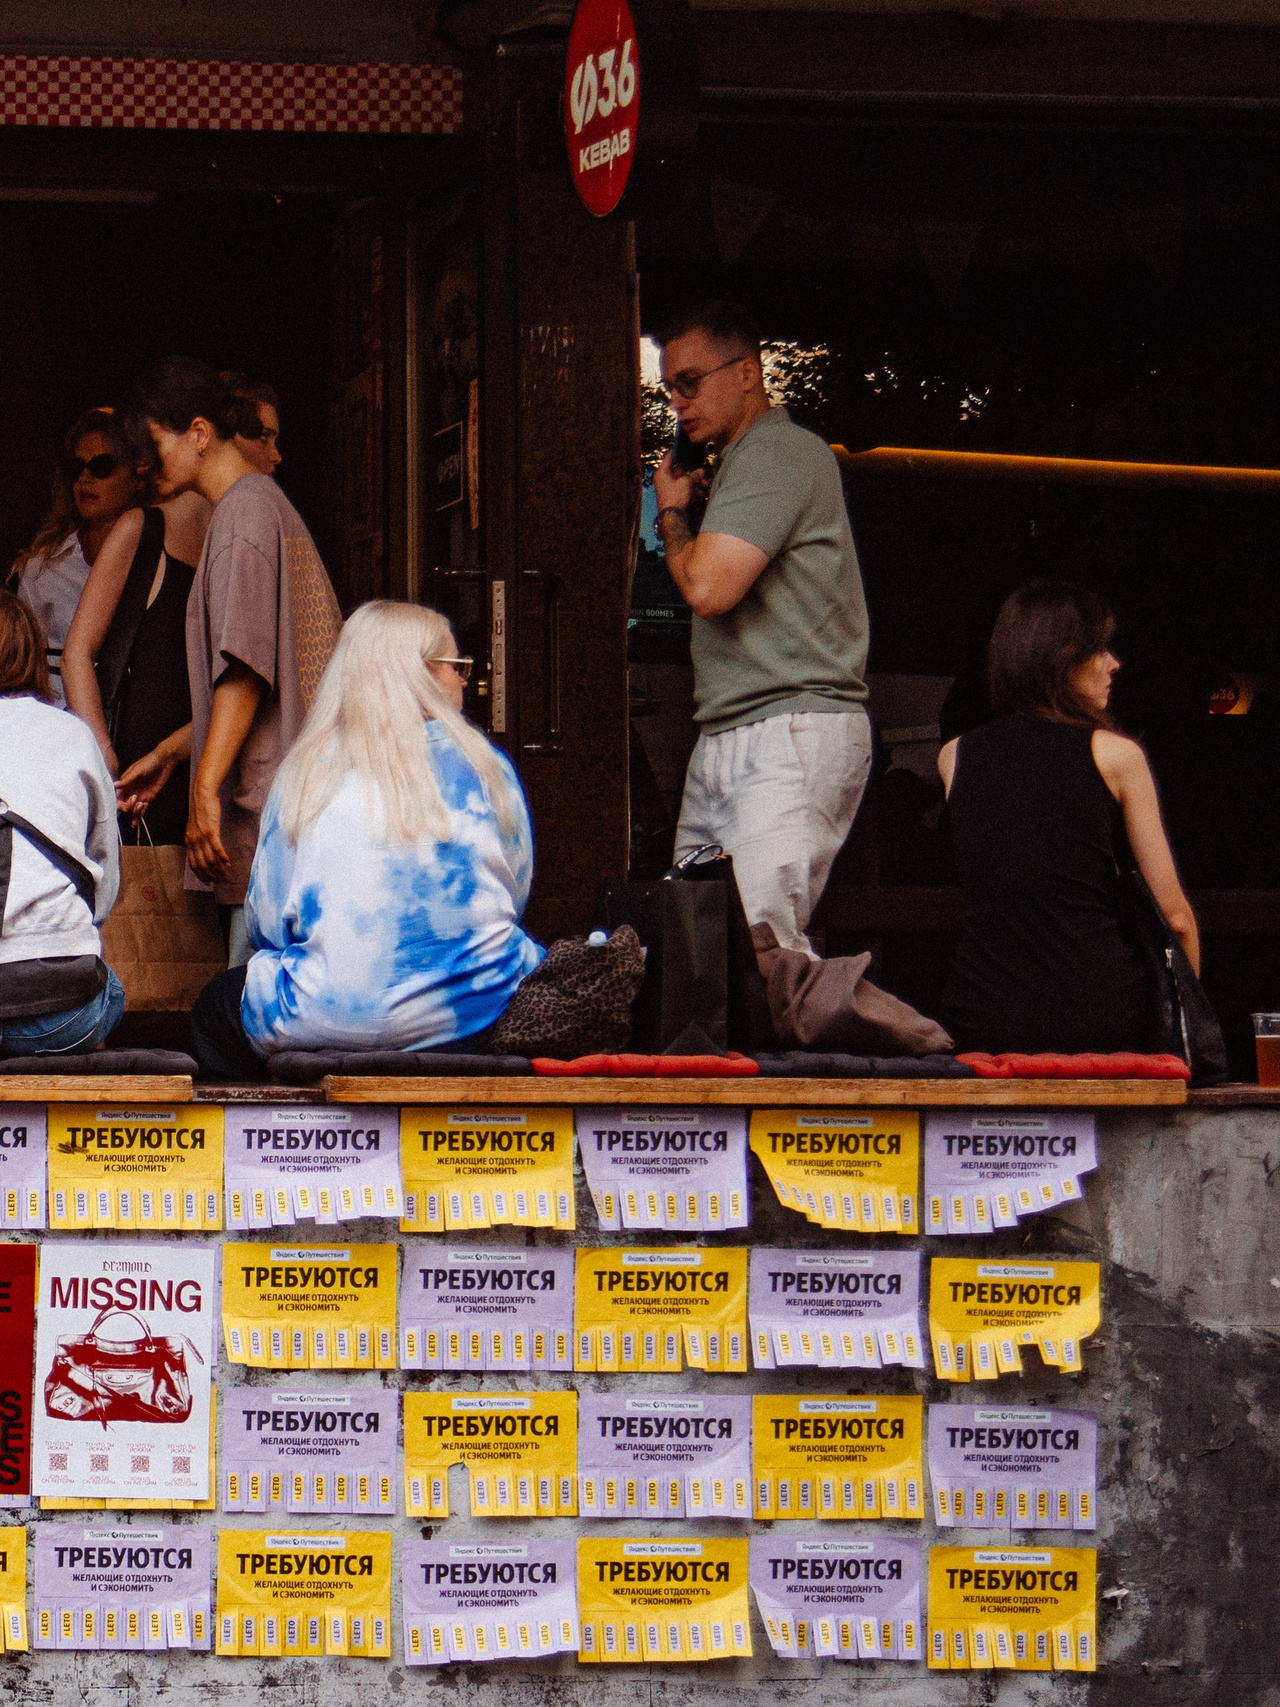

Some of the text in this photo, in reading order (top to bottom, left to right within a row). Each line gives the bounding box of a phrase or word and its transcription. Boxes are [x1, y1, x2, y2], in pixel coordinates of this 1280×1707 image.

[579, 129, 630, 173] KEBAB
[67, 1128, 205, 1149] ТРЕБУЮТСЯ
[243, 1128, 380, 1150] ТРЕБУЮТСЯ
[419, 1131, 555, 1152] ТРЕБУЮТСЯ
[593, 1131, 728, 1151] ТРЕБУЮТСЯ
[768, 1133, 901, 1155] ТРЕБУЮТСЯ
[944, 1135, 1076, 1156] ТРЕБУЮТСЯ
[85, 1155, 185, 1164] ЖЕЛАЮЩИЕ ОТДОХНУТЬ
[111, 1165, 166, 1173] СЭКОНОМИТЬ
[437, 1157, 535, 1166] ЖЕЛАЮЩИЕ ОТДОХНУТЬ
[241, 1267, 378, 1288] ТРЕБУЮТСЯ
[419, 1269, 555, 1290] ТРЕБУЮТСЯ
[594, 1271, 729, 1292] ТРЕБУЮТСЯ
[768, 1272, 901, 1294] ТРЕБУЮТСЯ
[50, 1277, 202, 1312] MISSING
[259, 1294, 358, 1302] ЖЕЛАЮЩИЕ ОТДОХНУТЬ
[611, 1298, 709, 1306] ЖЕЛАЮЩИЕ ОТДОХНУТЬ
[948, 1283, 1081, 1306] ТРЕБУЮТСЯ
[285, 1304, 340, 1312] СЭКОНОМИТЬ
[242, 1411, 380, 1433] ТРЕБУЮТСЯ
[423, 1416, 559, 1437] ТРЕБУЮТСЯ
[597, 1417, 732, 1439] ТРЕБУЮТСЯ
[771, 1419, 904, 1440] ТРЕБУЮТСЯ
[260, 1437, 359, 1447] ЖЕЛАЮЩИЕ ОТДОХНУТЬ
[946, 1428, 1079, 1450] ТРЕБУЮТСЯ
[286, 1448, 340, 1456] СЭКОНОМИТЬ
[964, 1455, 1060, 1464] ЖЕЛАЮЩИЕ ОТДОХНУТЬ
[988, 1465, 1041, 1473] СЭКОНОМИТЬ
[54, 1547, 193, 1569] ТРЕБУЮТСЯ
[236, 1554, 373, 1576] ТРЕБУЮТСЯ
[421, 1563, 557, 1585] ТРЕБУЮТСЯ
[595, 1562, 729, 1582] ТРЕБУЮТСЯ
[769, 1559, 902, 1580] ТРЕБУЮТСЯ
[254, 1581, 353, 1590] ЖЕЛАЮЩИЕ ОТДОХНУТЬ
[945, 1569, 1078, 1592] ТРЕБУЮТСЯ
[279, 1591, 334, 1599] СЭКОНОМИТЬ
[613, 1588, 710, 1596] ЖЕЛАЮЩИЕ ОТДОХНУТЬ
